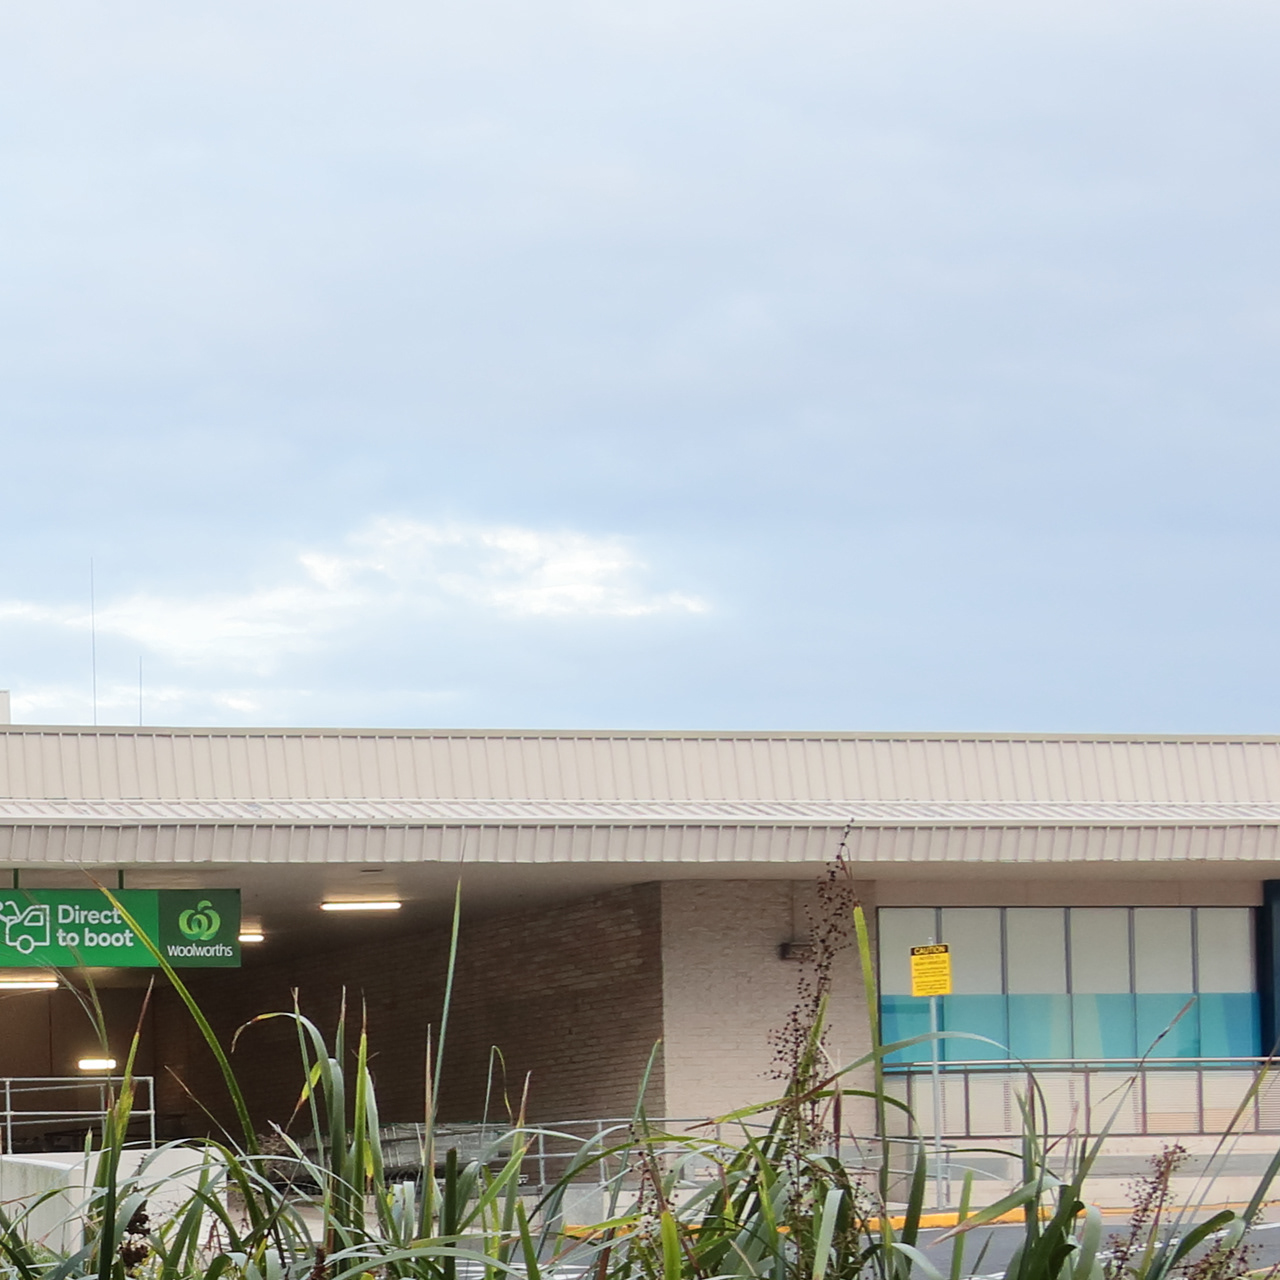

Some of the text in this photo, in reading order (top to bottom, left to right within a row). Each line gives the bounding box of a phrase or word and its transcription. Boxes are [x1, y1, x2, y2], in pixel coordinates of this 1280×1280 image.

[57, 904, 122, 925] Direct
[56, 927, 135, 947] to boot
[167, 943, 233, 957] Woolworths
